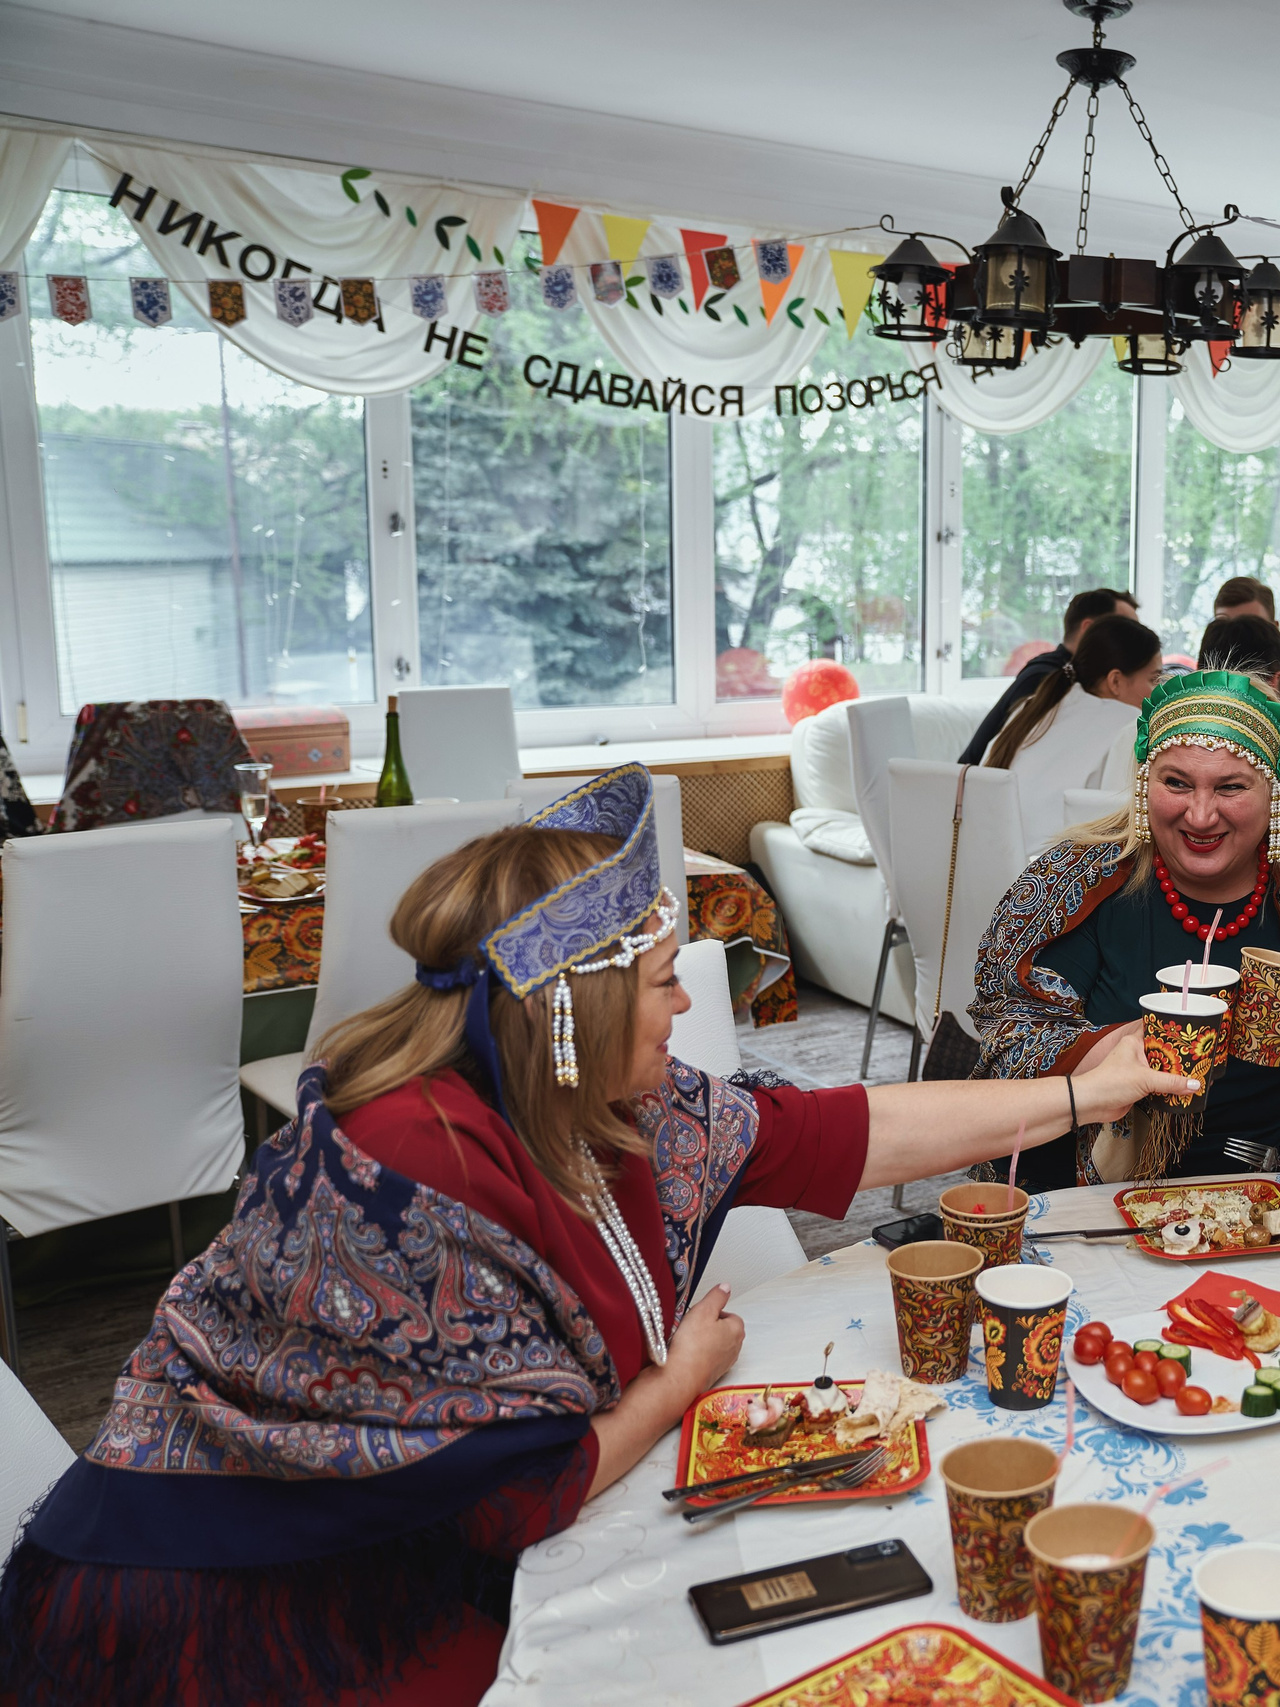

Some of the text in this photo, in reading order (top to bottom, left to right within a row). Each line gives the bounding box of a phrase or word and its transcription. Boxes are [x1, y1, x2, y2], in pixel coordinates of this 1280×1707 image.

[424, 320, 489, 370] НЕ
[523, 354, 744, 417] СДАВАЙСЯ
[775, 362, 943, 417] ПОЗОРЬСЯ
